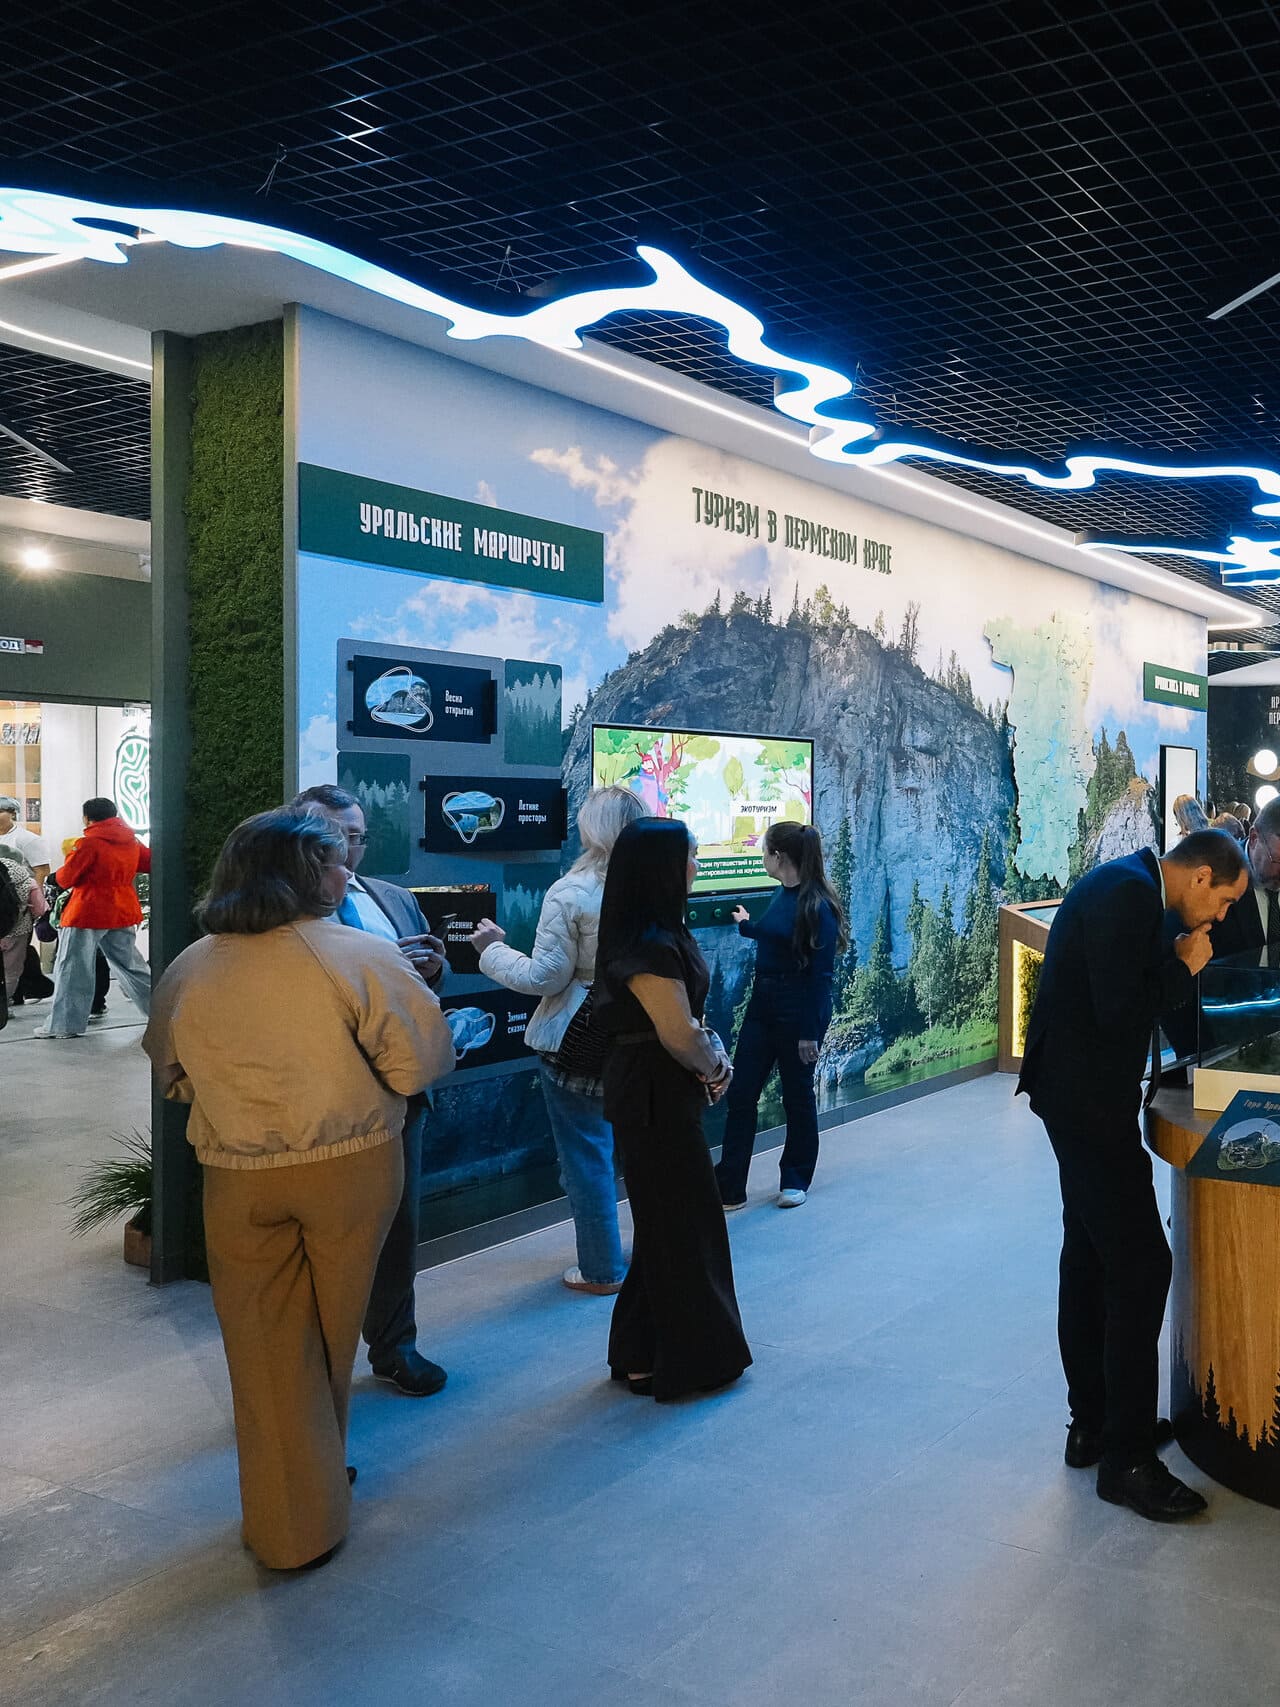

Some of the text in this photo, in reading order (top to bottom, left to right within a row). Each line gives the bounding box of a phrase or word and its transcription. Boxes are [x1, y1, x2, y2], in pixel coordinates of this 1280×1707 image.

[360, 502, 565, 572] УРАЛЬСКИЕ МАРШРУТЫ
[692, 487, 892, 575] ТУРИЗМ В ПЕРМСКОМ КРАЕ
[0, 640, 19, 650] ОД
[445, 689, 463, 704] Весна
[445, 705, 474, 717] открытий
[518, 799, 539, 811] Летние
[740, 805, 777, 813] ЭКОТУРИЗМ
[518, 813, 547, 825] просторы
